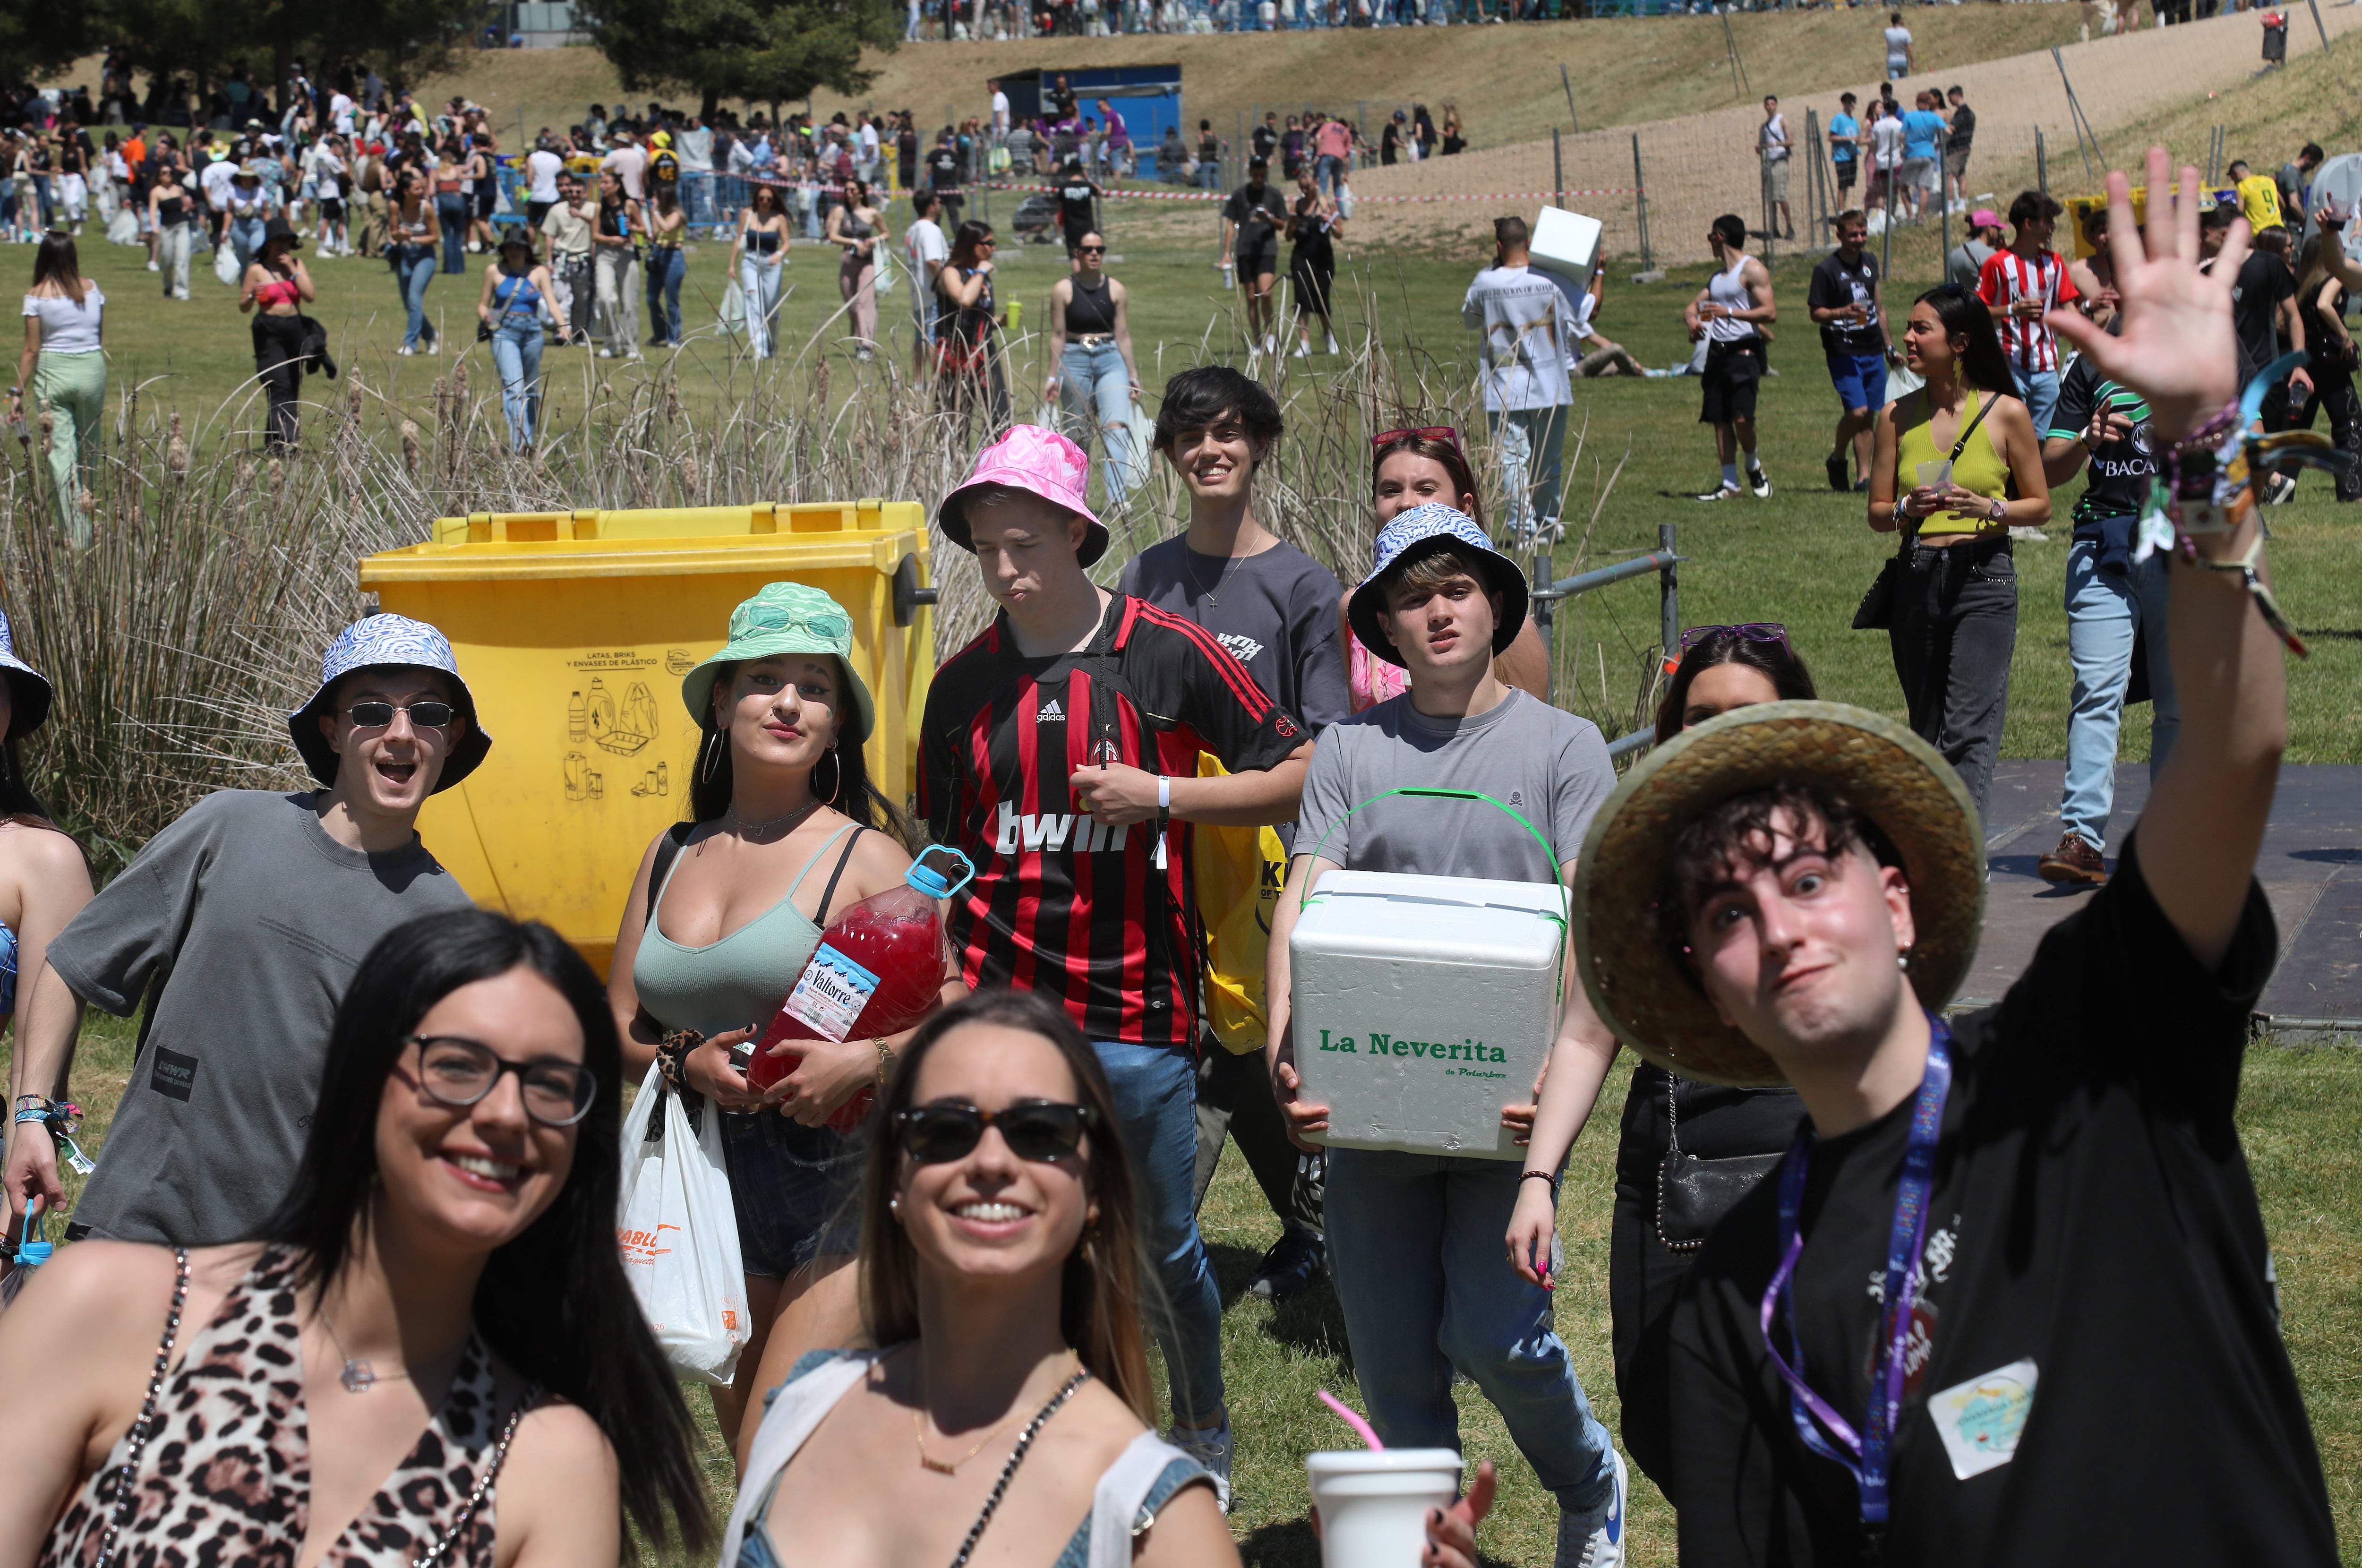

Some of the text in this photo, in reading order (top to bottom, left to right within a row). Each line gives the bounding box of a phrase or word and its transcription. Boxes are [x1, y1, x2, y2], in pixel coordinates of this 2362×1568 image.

[1535, 283, 1554, 292] ADAM
[1036, 714, 1066, 723] adidas
[995, 800, 1130, 855] bwin
[808, 986, 818, 994] Agua
[818, 992, 832, 1002] mineral
[832, 1002, 847, 1012] natural
[813, 969, 851, 1005] Valtorre
[1319, 1029, 1507, 1063] La Neverita
[1458, 1068, 1507, 1079] Polarbox
